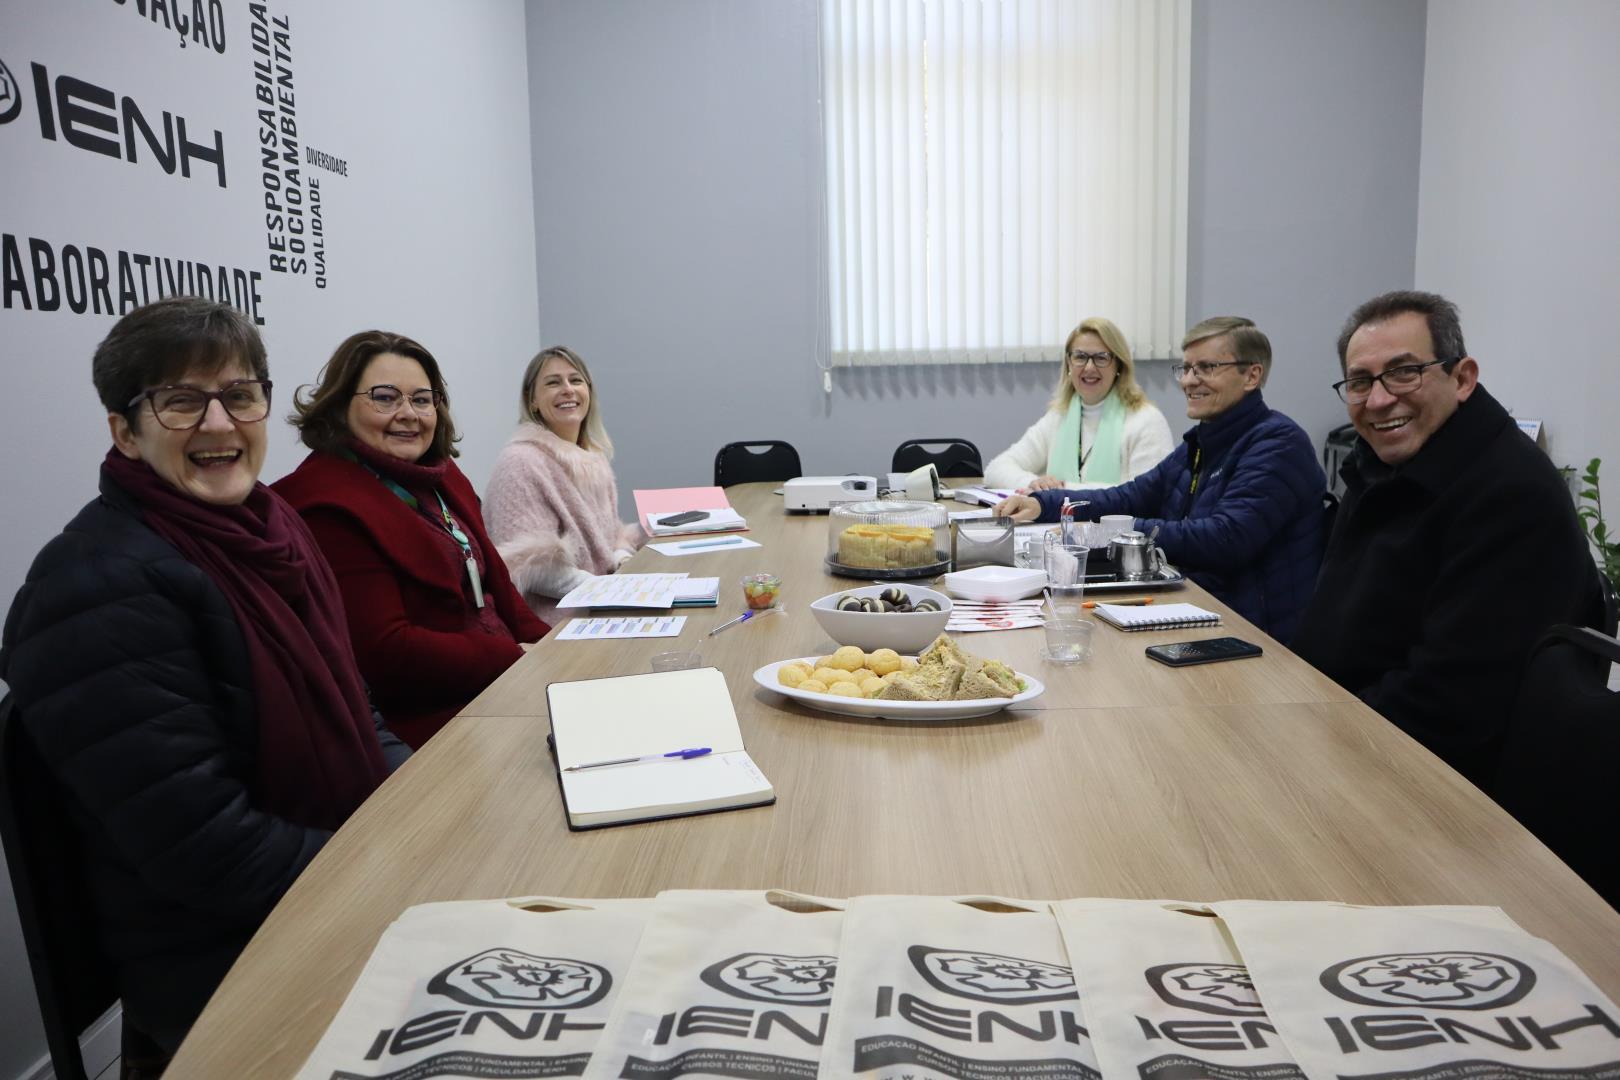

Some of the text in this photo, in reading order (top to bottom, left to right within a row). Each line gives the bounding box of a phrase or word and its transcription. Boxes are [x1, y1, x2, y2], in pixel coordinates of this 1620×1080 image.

[30, 60, 228, 189] IENH
[249, 0, 288, 274] RESPONSABILIDA
[272, 14, 307, 275] SOCIOAMBIENTAL
[306, 146, 349, 177] DIVERSIDADE
[308, 177, 327, 290] QUALIDADE
[474, 1056, 546, 1067] FUNDAMENTAL
[967, 1062, 1007, 1073] ENSINO
[1008, 1063, 1084, 1074] FUNDAMENTAL
[1323, 1003, 1620, 1054] IENH
